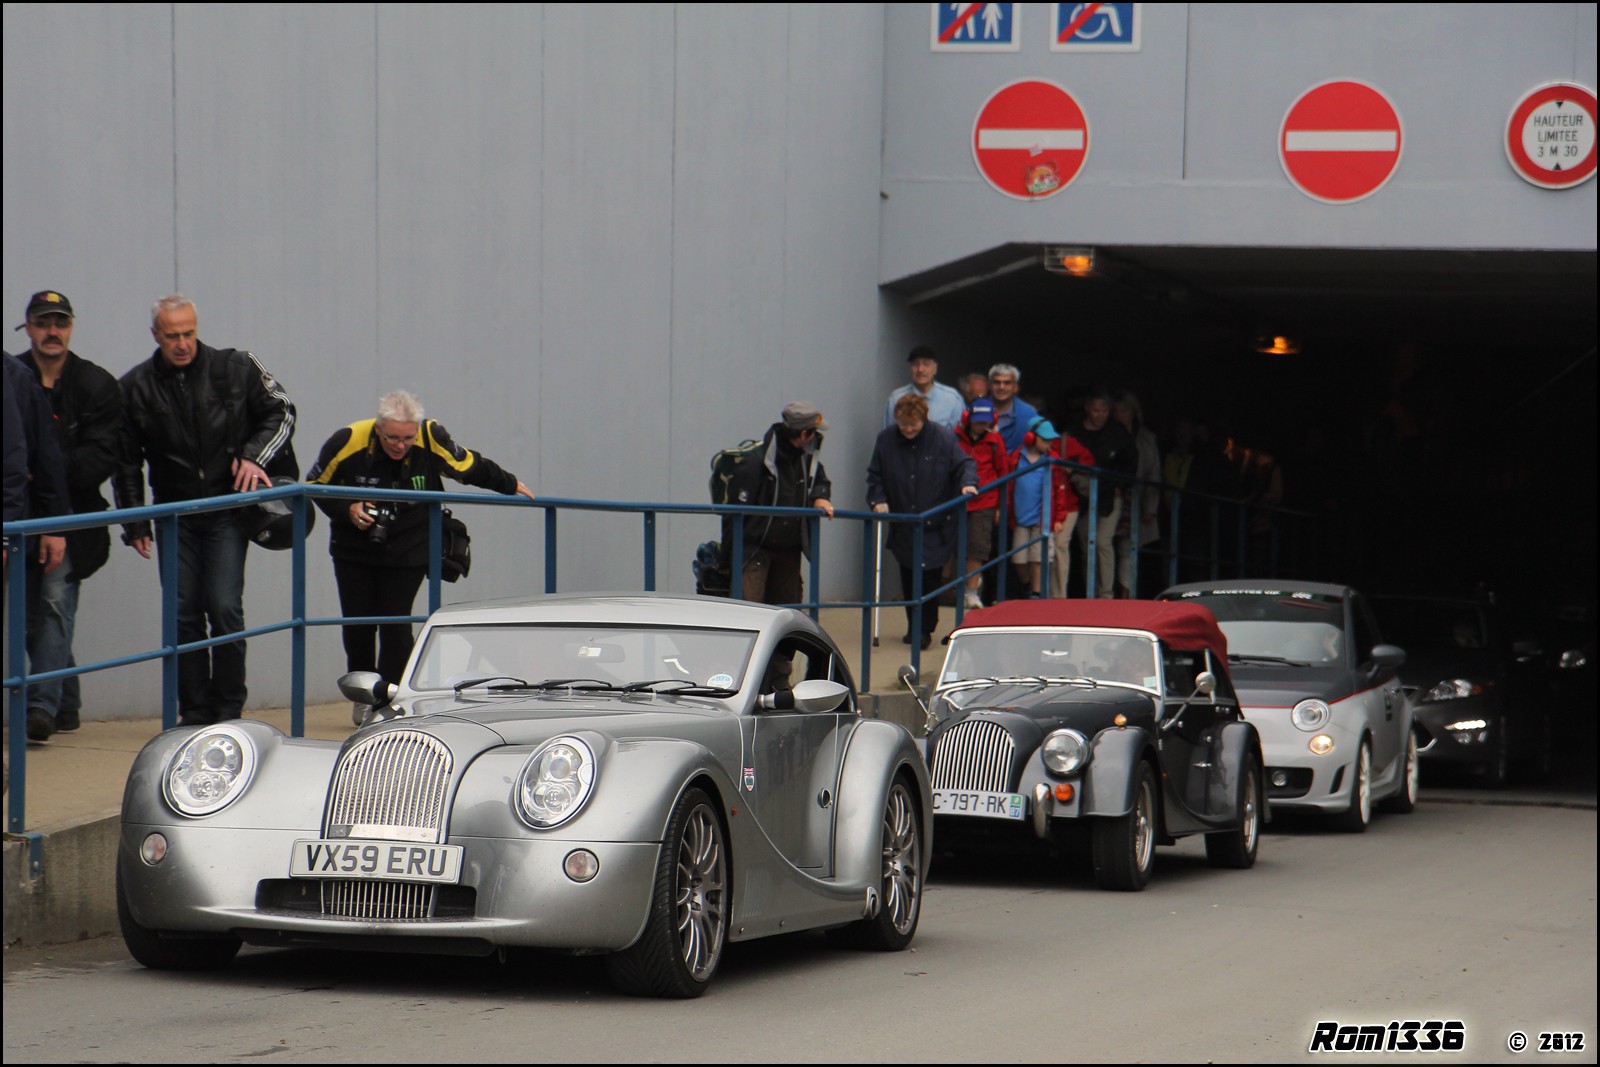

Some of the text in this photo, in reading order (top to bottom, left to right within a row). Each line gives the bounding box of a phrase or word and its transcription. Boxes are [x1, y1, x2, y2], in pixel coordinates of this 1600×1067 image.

[1533, 115, 1583, 127] HAUTEUR
[1537, 130, 1578, 142] LIMITEE
[1537, 145, 1578, 157] 3 M 30
[933, 792, 1007, 814] C-797-RK
[306, 844, 448, 876] VX59 ERU
